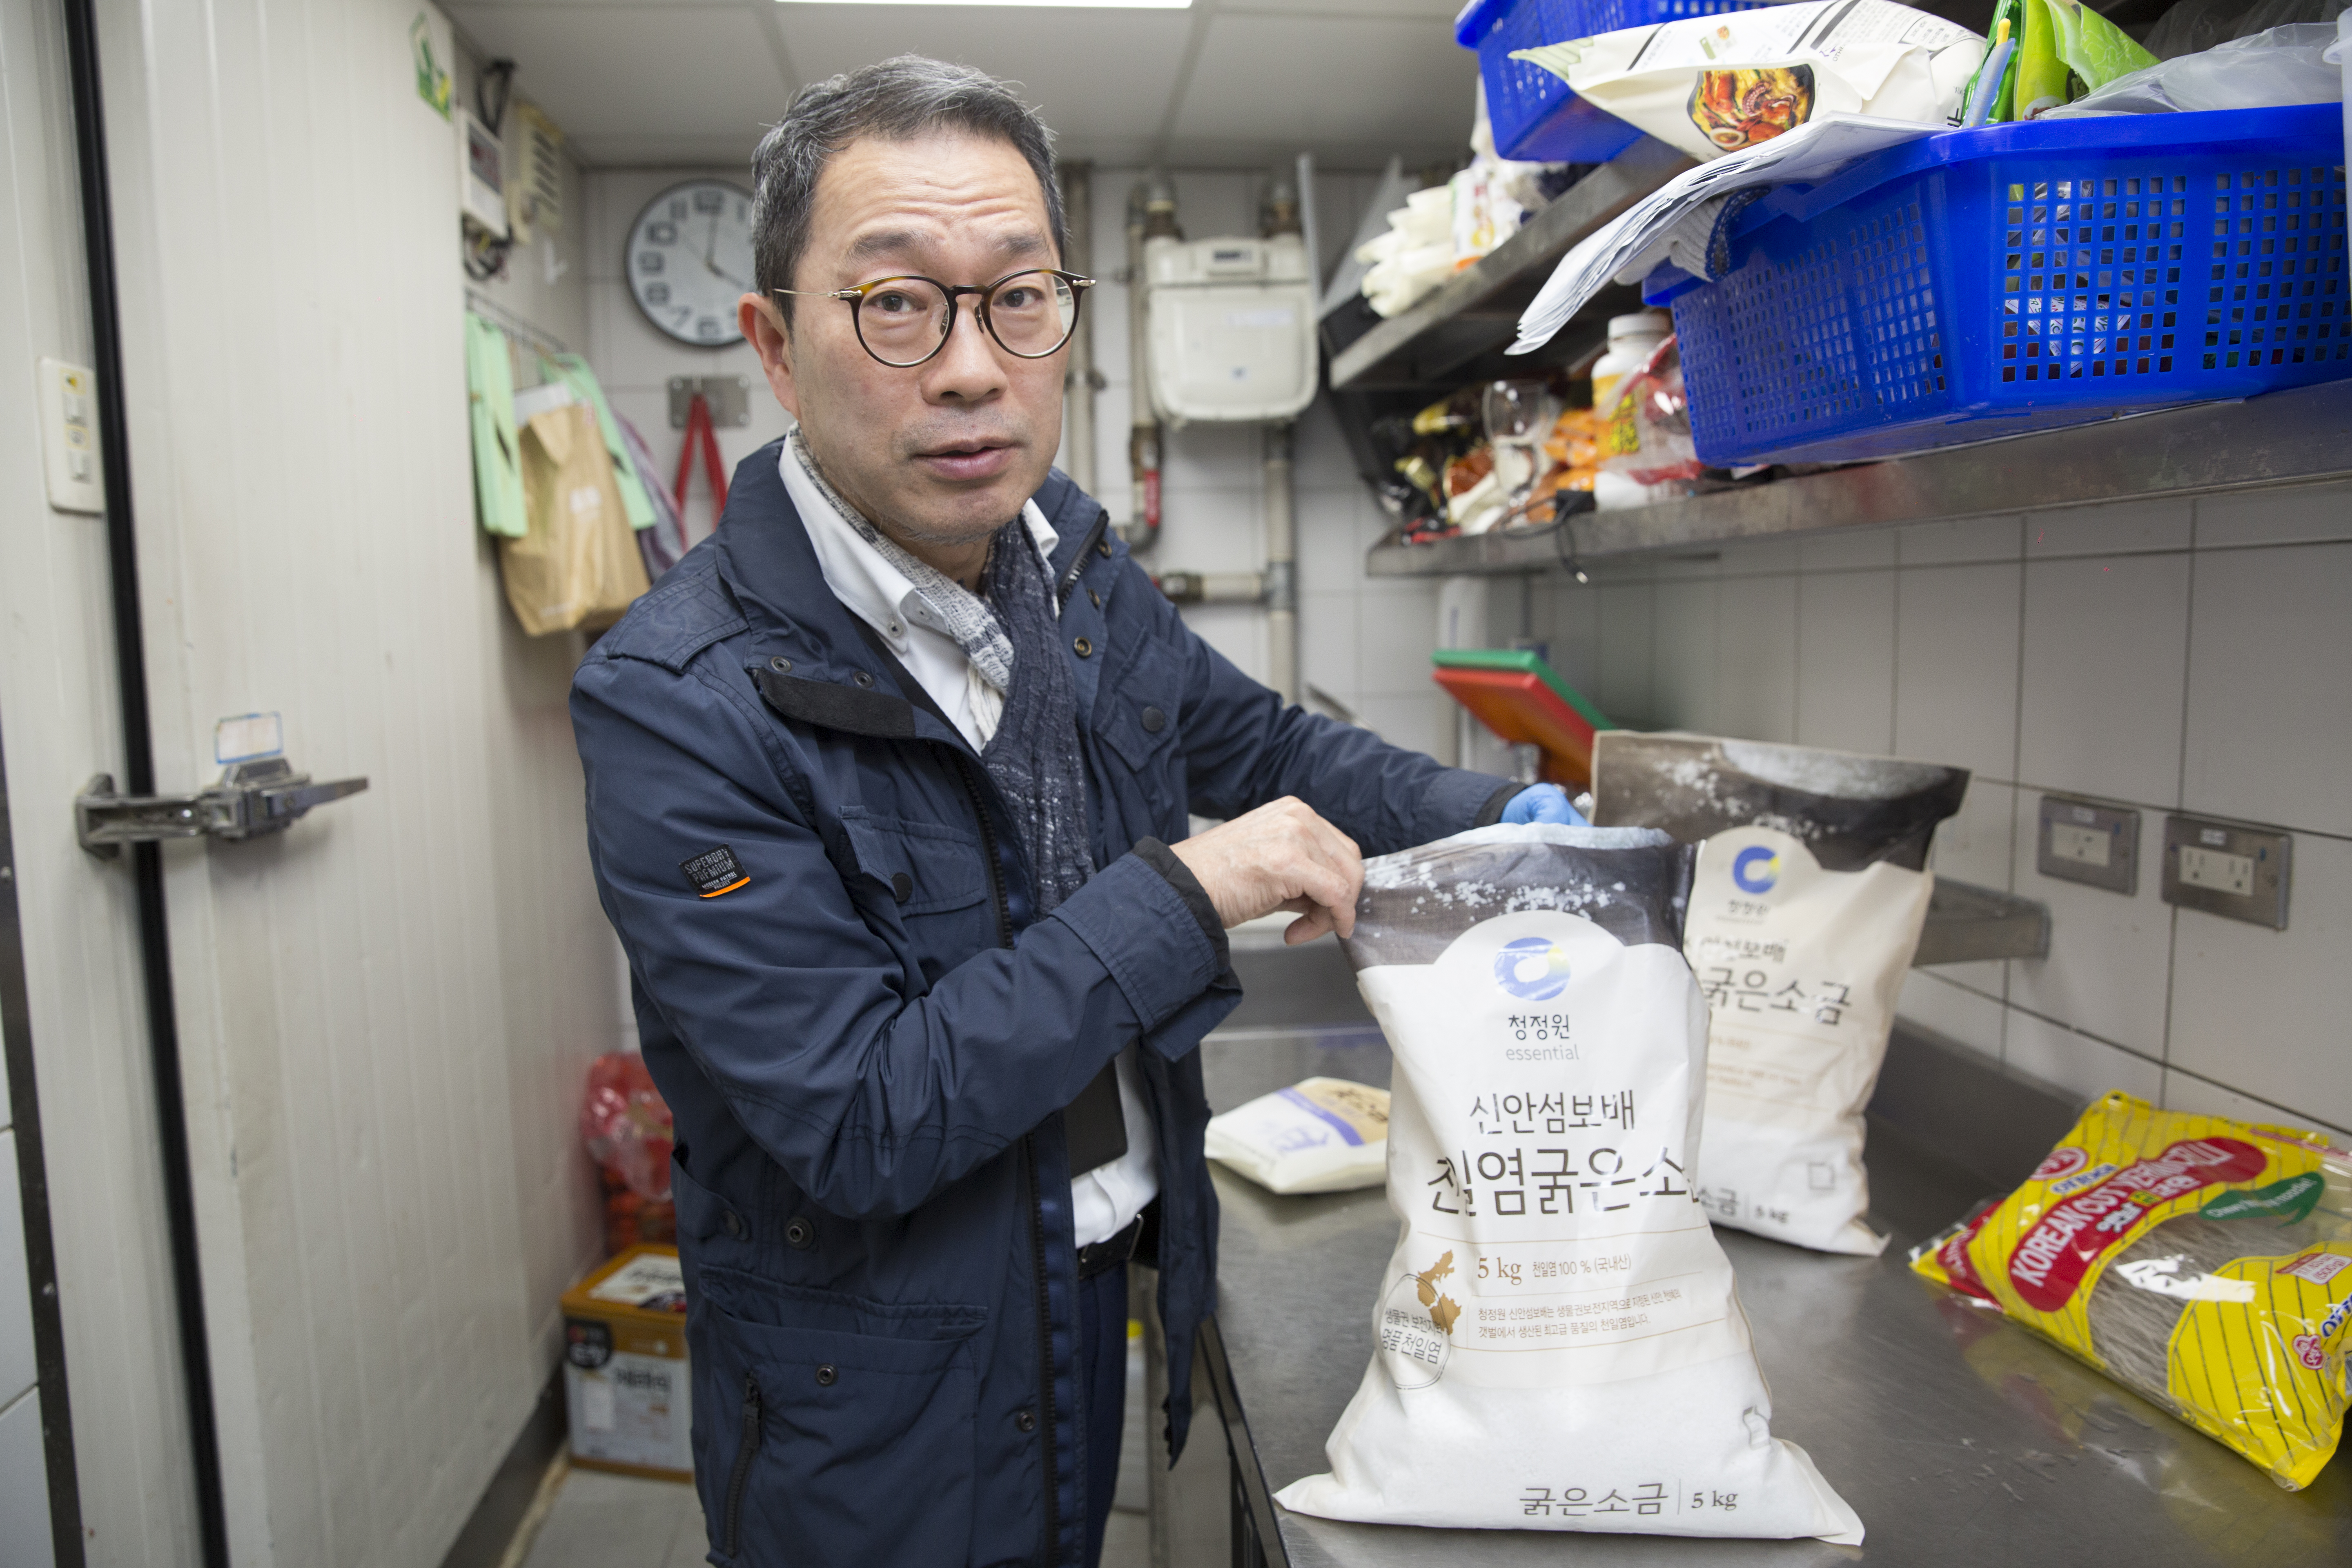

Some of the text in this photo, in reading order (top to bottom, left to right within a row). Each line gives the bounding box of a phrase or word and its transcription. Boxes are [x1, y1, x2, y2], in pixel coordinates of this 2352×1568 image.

[1832, 44, 1846, 62] OTHE
[692, 857, 735, 883] PREMIUM
[702, 871, 737, 889] MODERN PATROL
[714, 880, 731, 890] PROJECT
[1508, 1014, 1570, 1040] 청정원
[1506, 1043, 1579, 1060] essential
[1470, 1089, 1635, 1134] 신안섬보배
[2011, 1206, 2094, 1287] KOREAN
[1478, 1253, 1631, 1285] 5 kg 천일염 100 % (국내산)
[1478, 1308, 1506, 1321] 청정원
[1509, 1306, 1555, 1321] 신안섬보배는
[1478, 1326, 1515, 1339] 갯벌에서
[1518, 1325, 1542, 1339] 생산된
[1544, 1323, 1568, 1336] 최고급
[1570, 1320, 1598, 1334] 품질의
[1382, 1328, 1443, 1365] 명품 천일염
[1519, 1482, 1738, 1516] 굵은소금 5 kg
